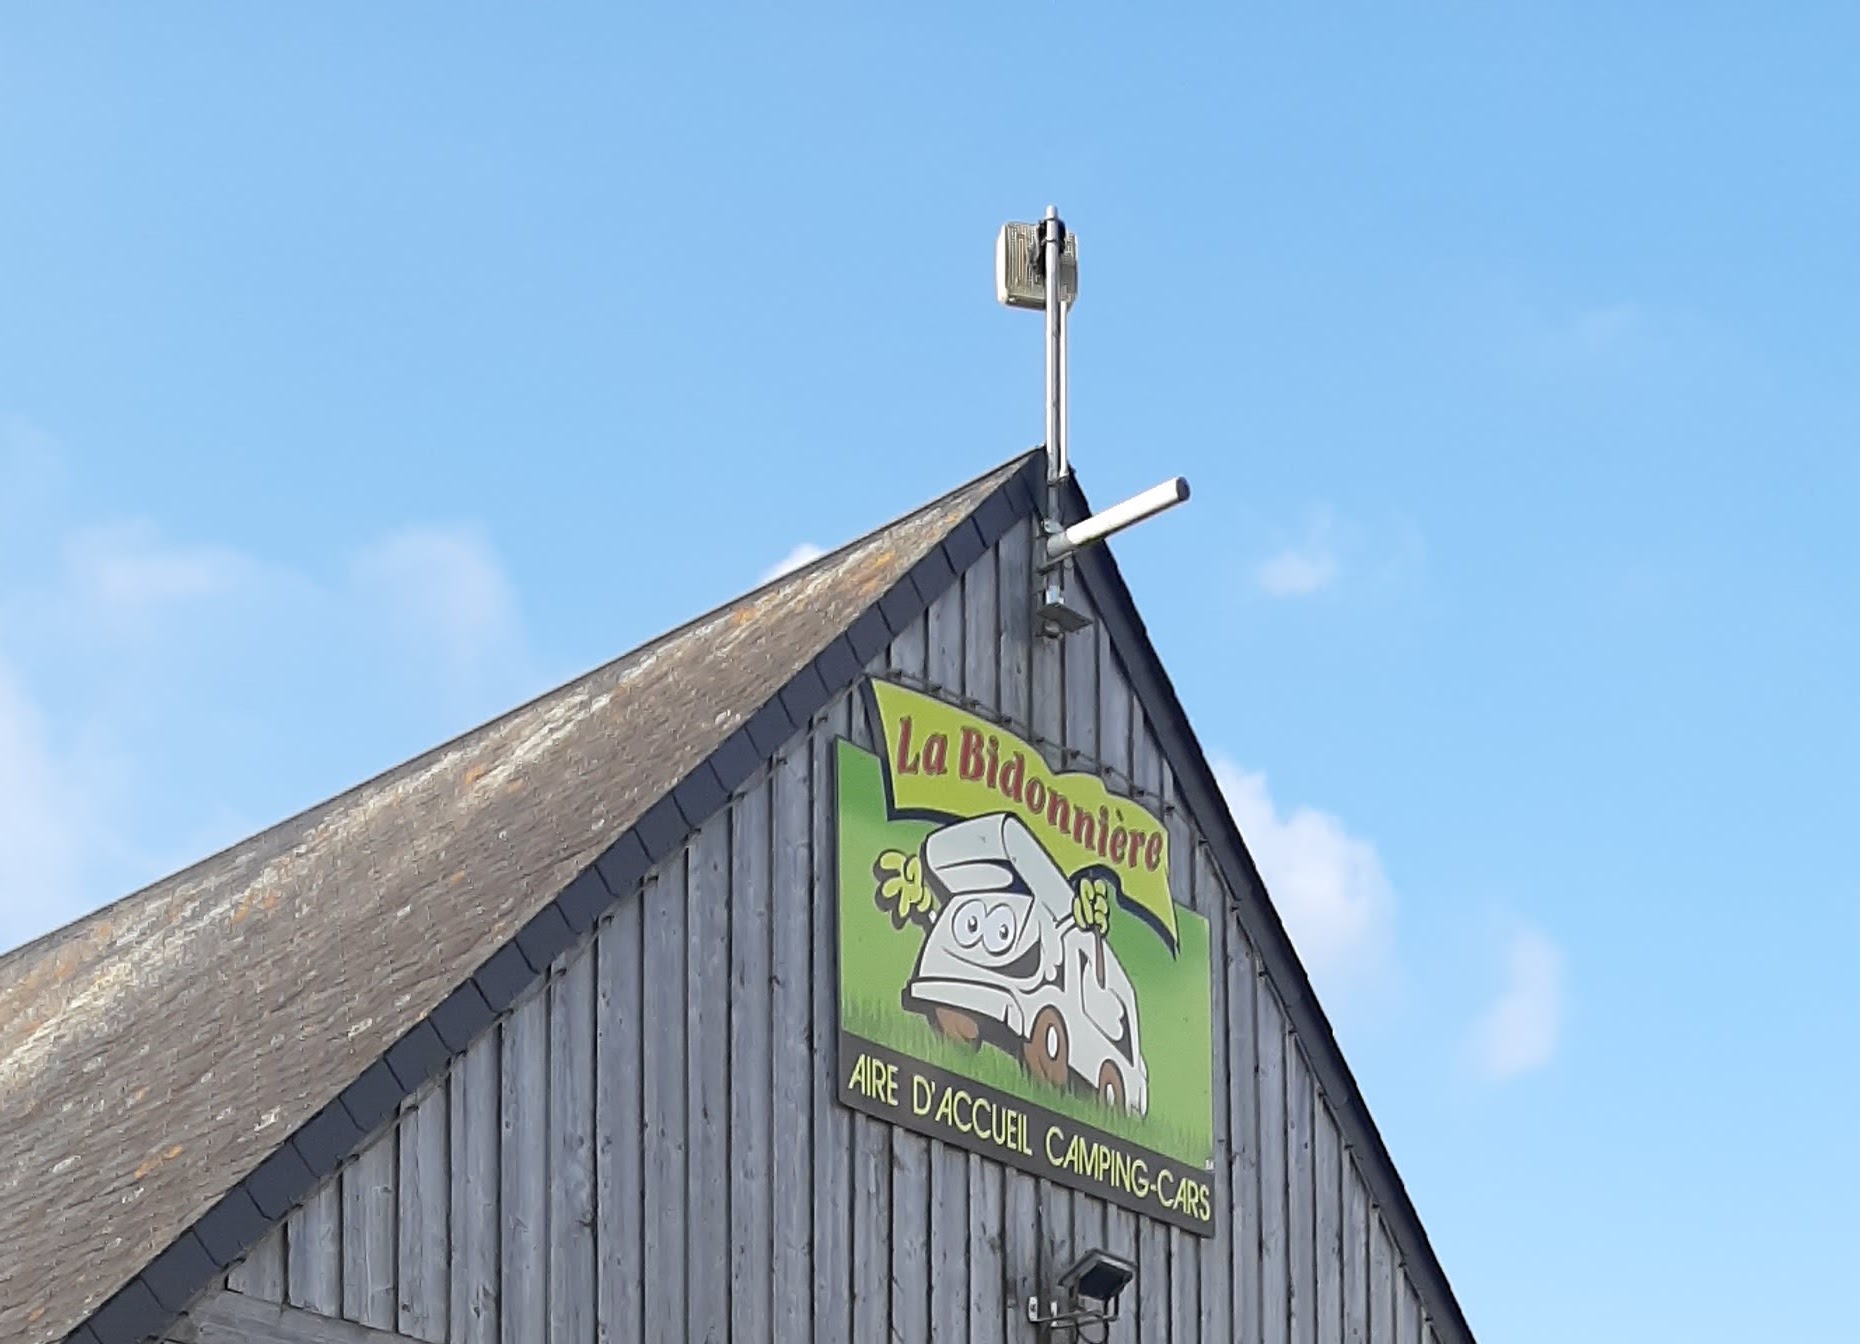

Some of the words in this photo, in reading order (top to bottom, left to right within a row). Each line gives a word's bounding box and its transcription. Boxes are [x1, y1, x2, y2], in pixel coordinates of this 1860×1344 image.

[897, 715, 948, 776] La
[958, 725, 1163, 872] Bidonnière
[848, 1053, 899, 1106] AIRE
[912, 1074, 1033, 1156] D'ACCUEIL
[1045, 1125, 1211, 1221] CAMPING-CARS
